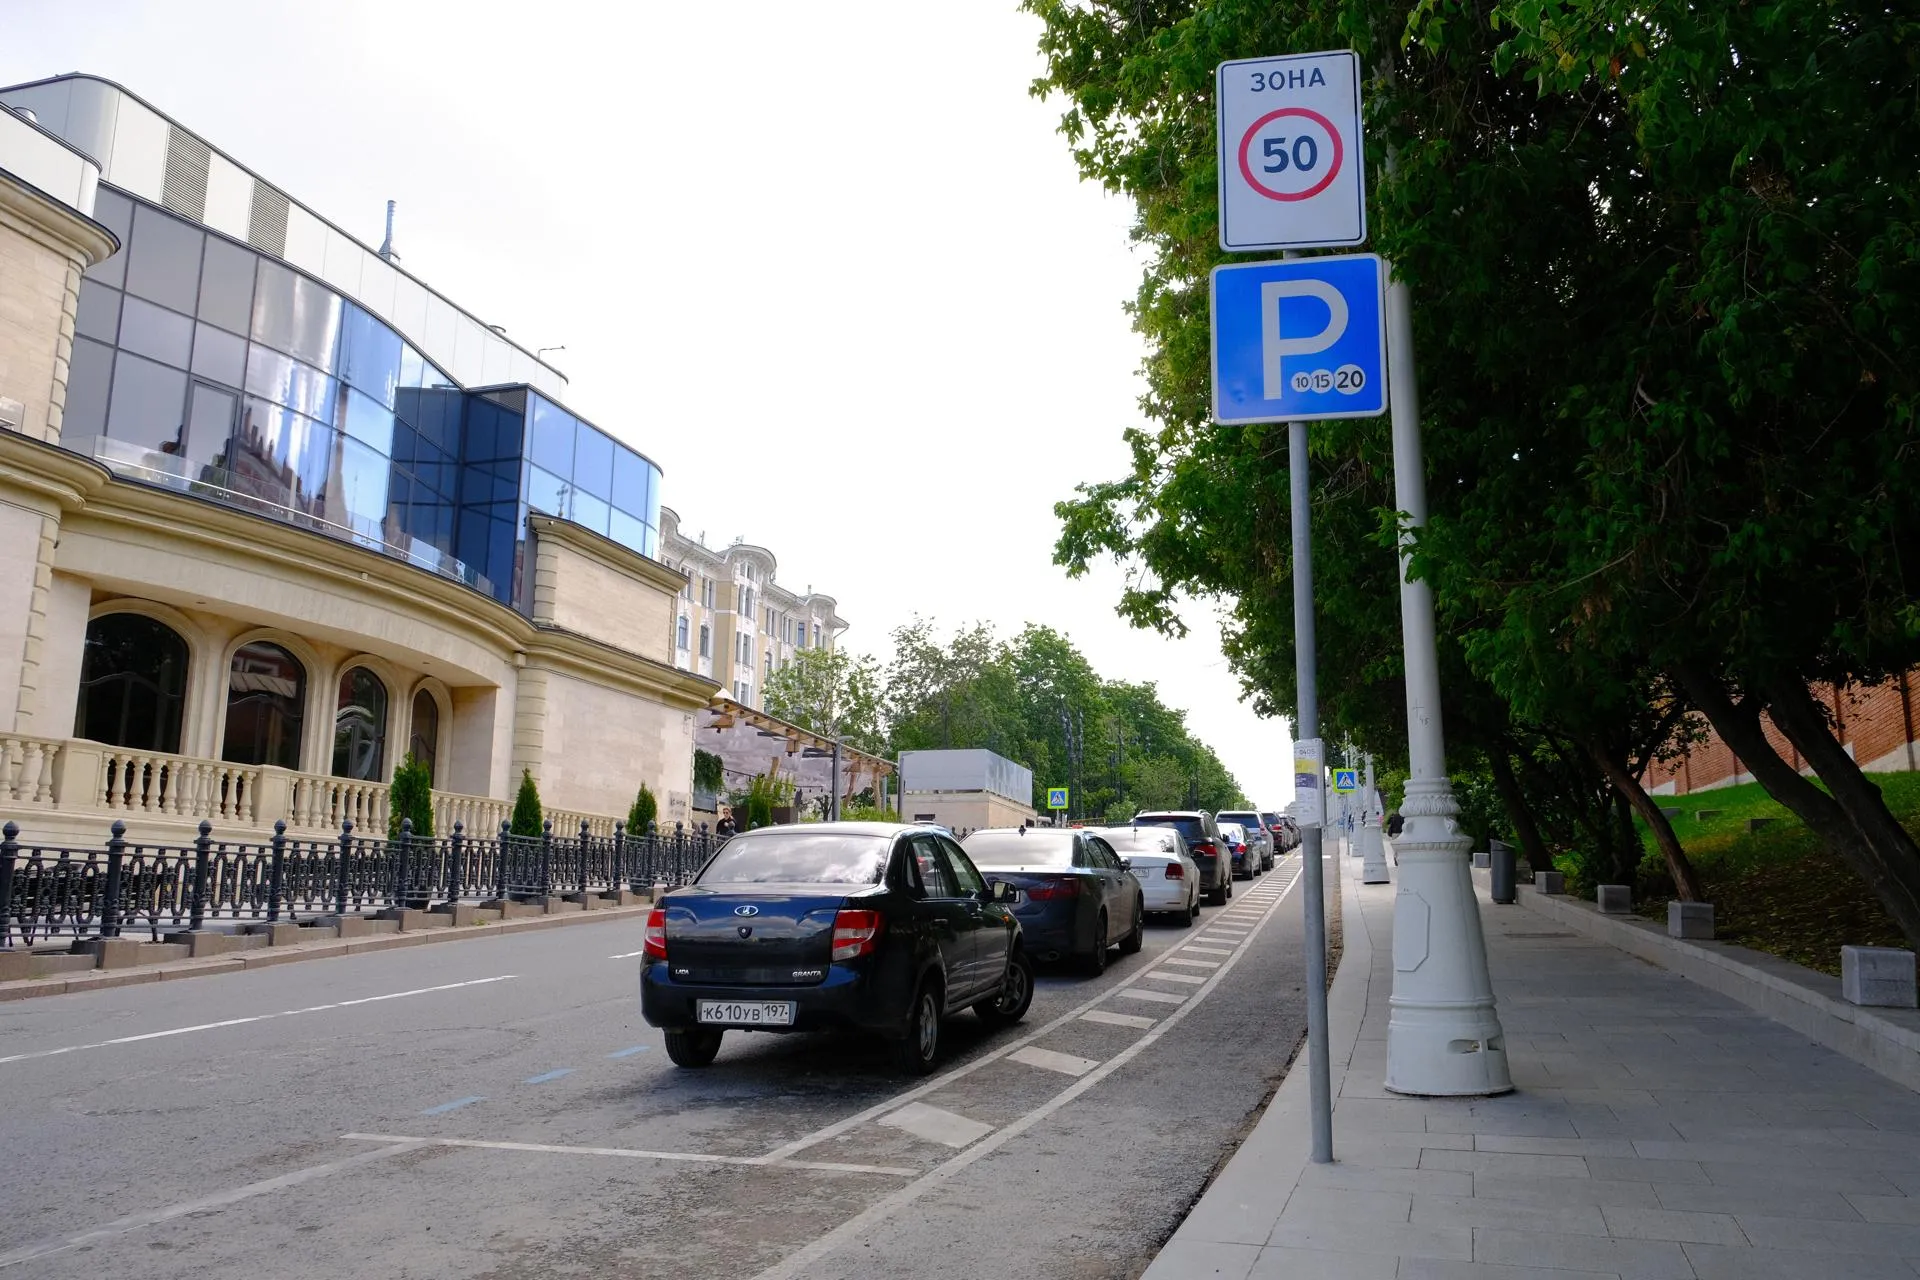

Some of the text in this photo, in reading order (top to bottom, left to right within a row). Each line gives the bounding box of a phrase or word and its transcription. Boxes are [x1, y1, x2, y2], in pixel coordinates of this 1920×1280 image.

[1250, 67, 1326, 92] ЗОНА
[1263, 135, 1318, 173] 50
[1261, 279, 1349, 400] P
[1296, 370, 1363, 389] 10 15 20
[792, 970, 821, 978] GRANTA
[764, 1004, 785, 1017] 197
